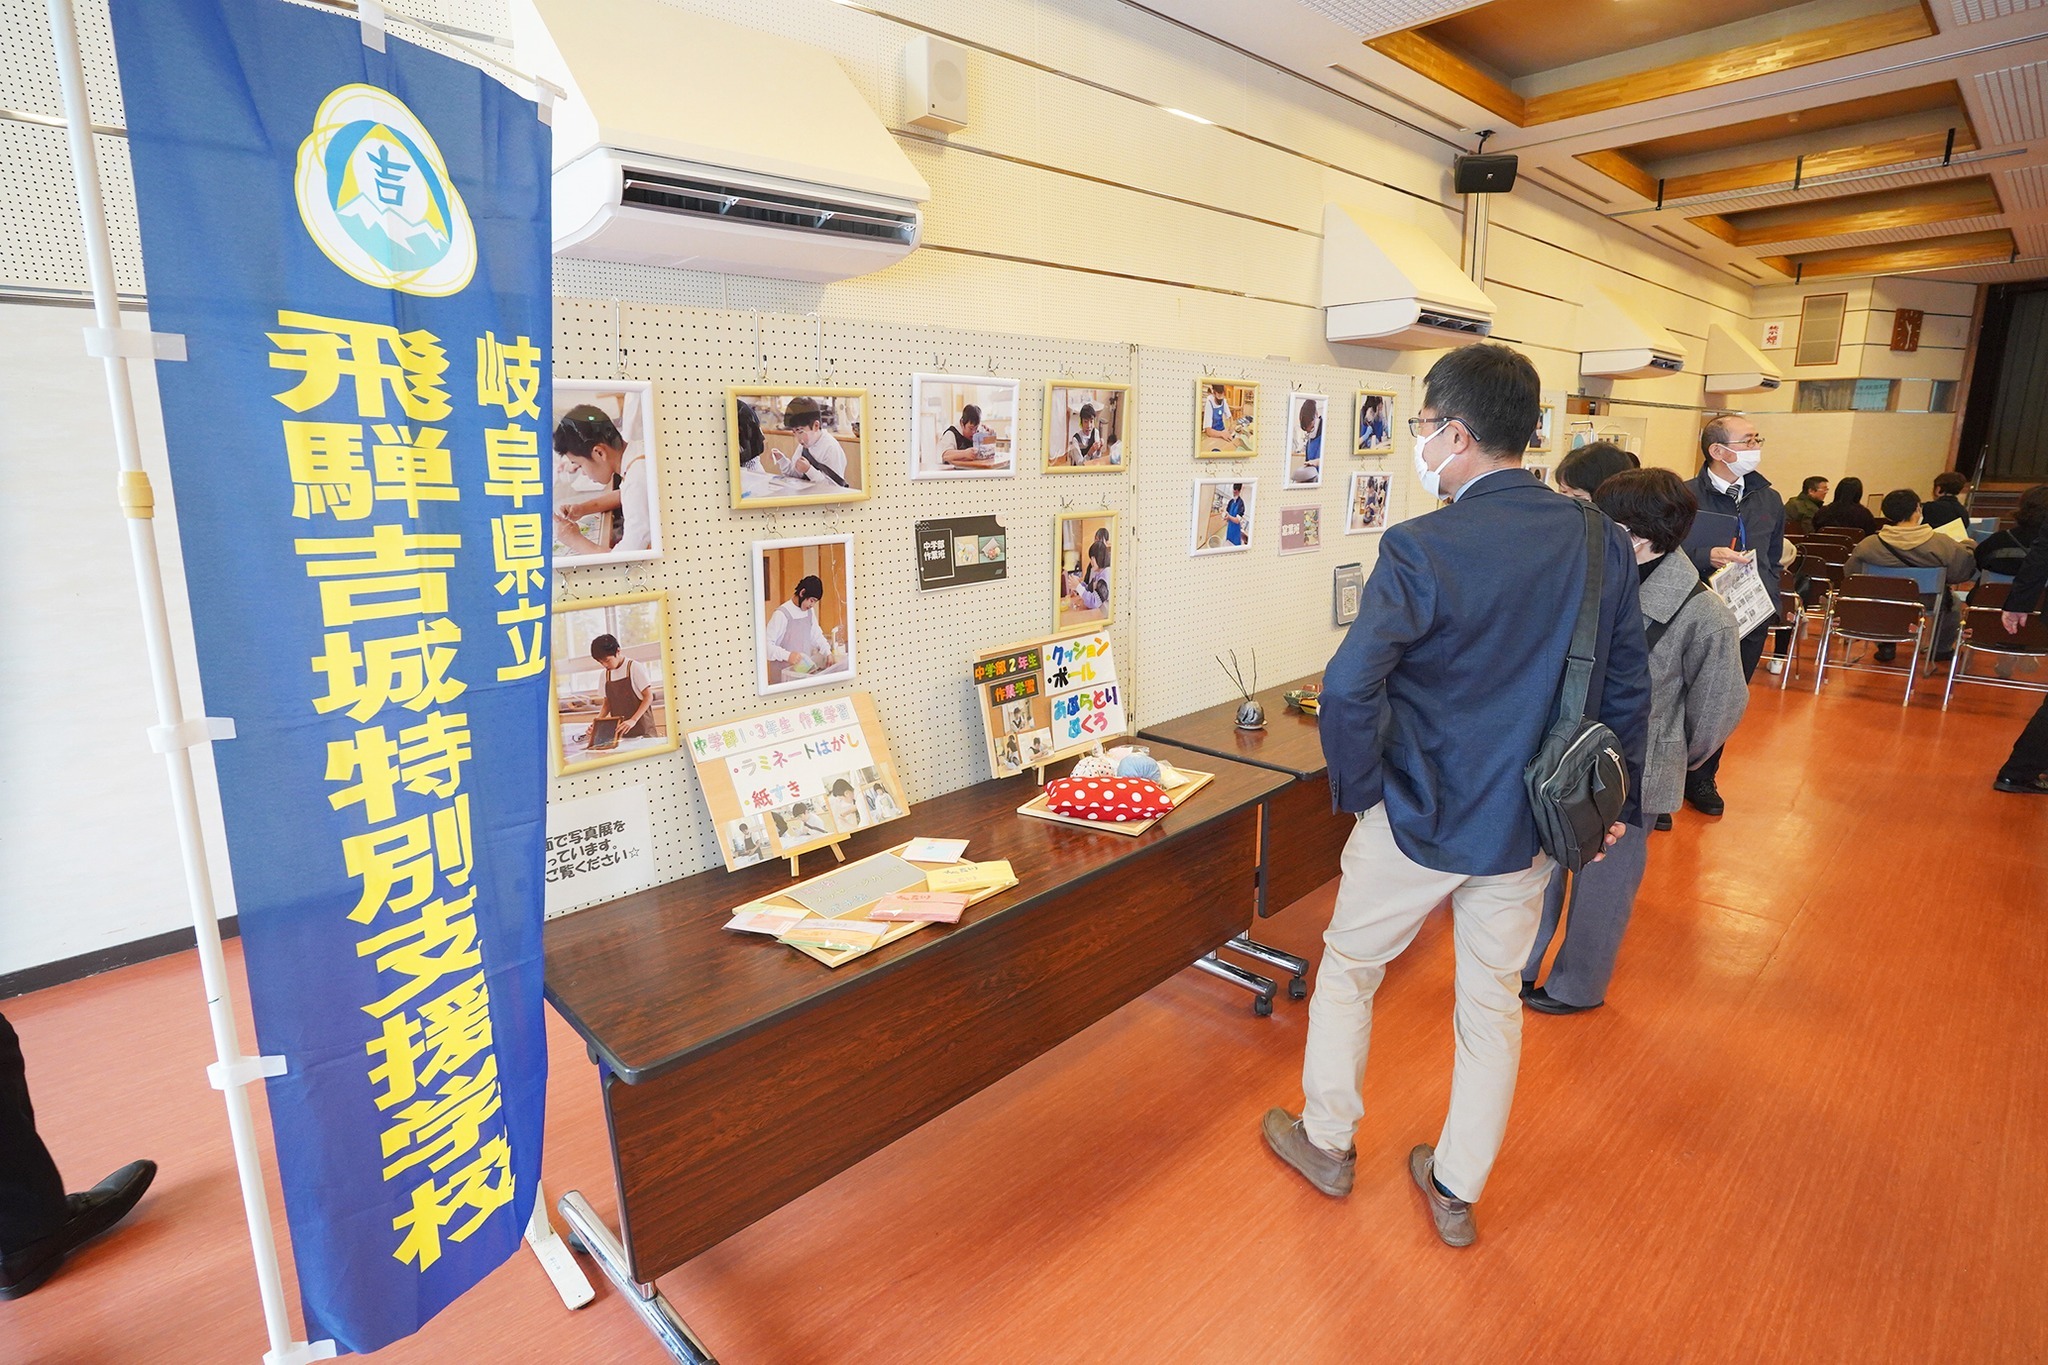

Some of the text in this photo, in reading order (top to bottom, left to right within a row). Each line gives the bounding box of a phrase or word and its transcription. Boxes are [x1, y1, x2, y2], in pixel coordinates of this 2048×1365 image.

[1766, 325, 1779, 345] 禁煙
[476, 331, 546, 682] 岐阜県立
[923, 540, 945, 551] 中学部
[974, 653, 1039, 680] 中学部2年生
[994, 679, 1035, 702] 作業学習
[1054, 686, 1118, 720] あぶらとり
[799, 703, 850, 729] 作業学習
[265, 309, 516, 1273] 飛騨吉城特別支援学校
